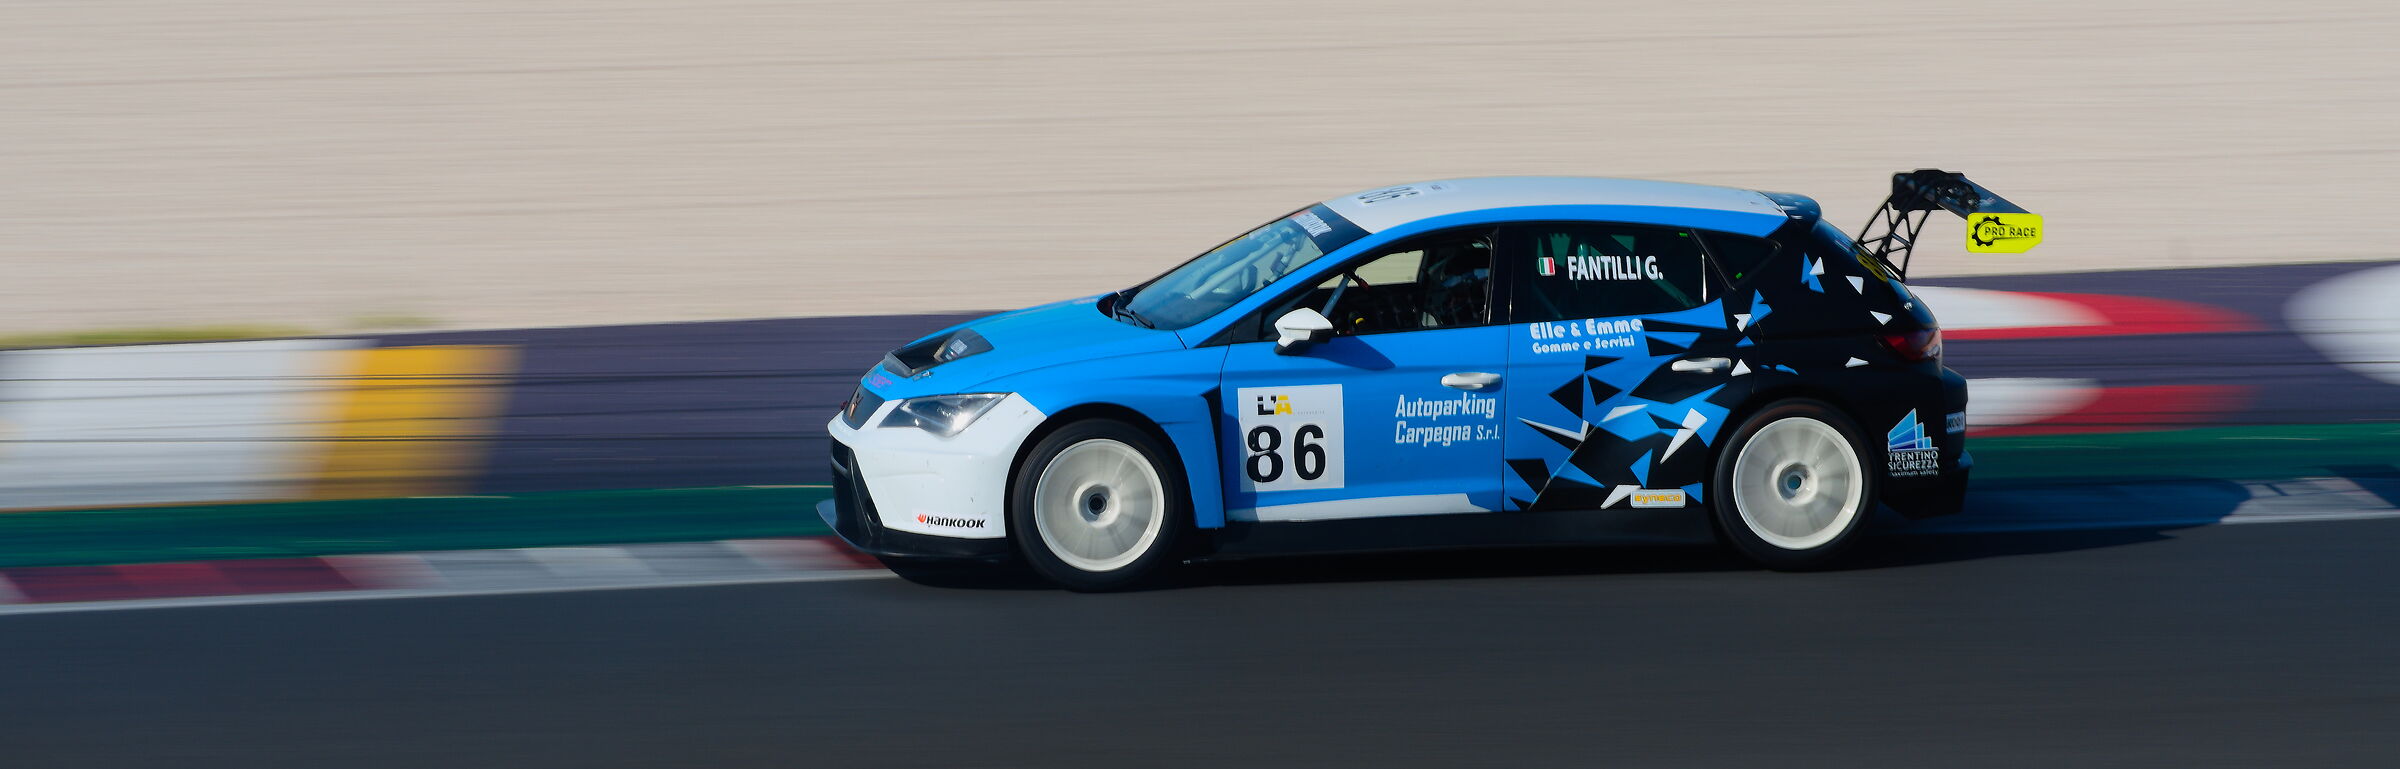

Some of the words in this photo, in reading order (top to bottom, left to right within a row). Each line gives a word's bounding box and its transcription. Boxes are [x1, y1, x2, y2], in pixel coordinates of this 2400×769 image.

[1984, 226, 2005, 236] PRO
[2009, 226, 2037, 237] RACE
[1567, 255, 1641, 280] FANTILLI
[1644, 255, 1664, 280] G.
[1529, 322, 1566, 340] Elle
[1570, 322, 1581, 337] &
[1585, 318, 1642, 335] Emme
[1532, 342, 1580, 354] Gomme
[1583, 340, 1592, 350] e
[1594, 334, 1635, 349] Servizi
[1395, 391, 1496, 421] Autoparking
[1395, 420, 1471, 447] Carpegna
[1476, 424, 1499, 440] S.r.l.
[1246, 424, 1326, 483] 86
[1888, 450, 1939, 462] TRENTINO
[1888, 460, 1939, 471] SICUREZZA
